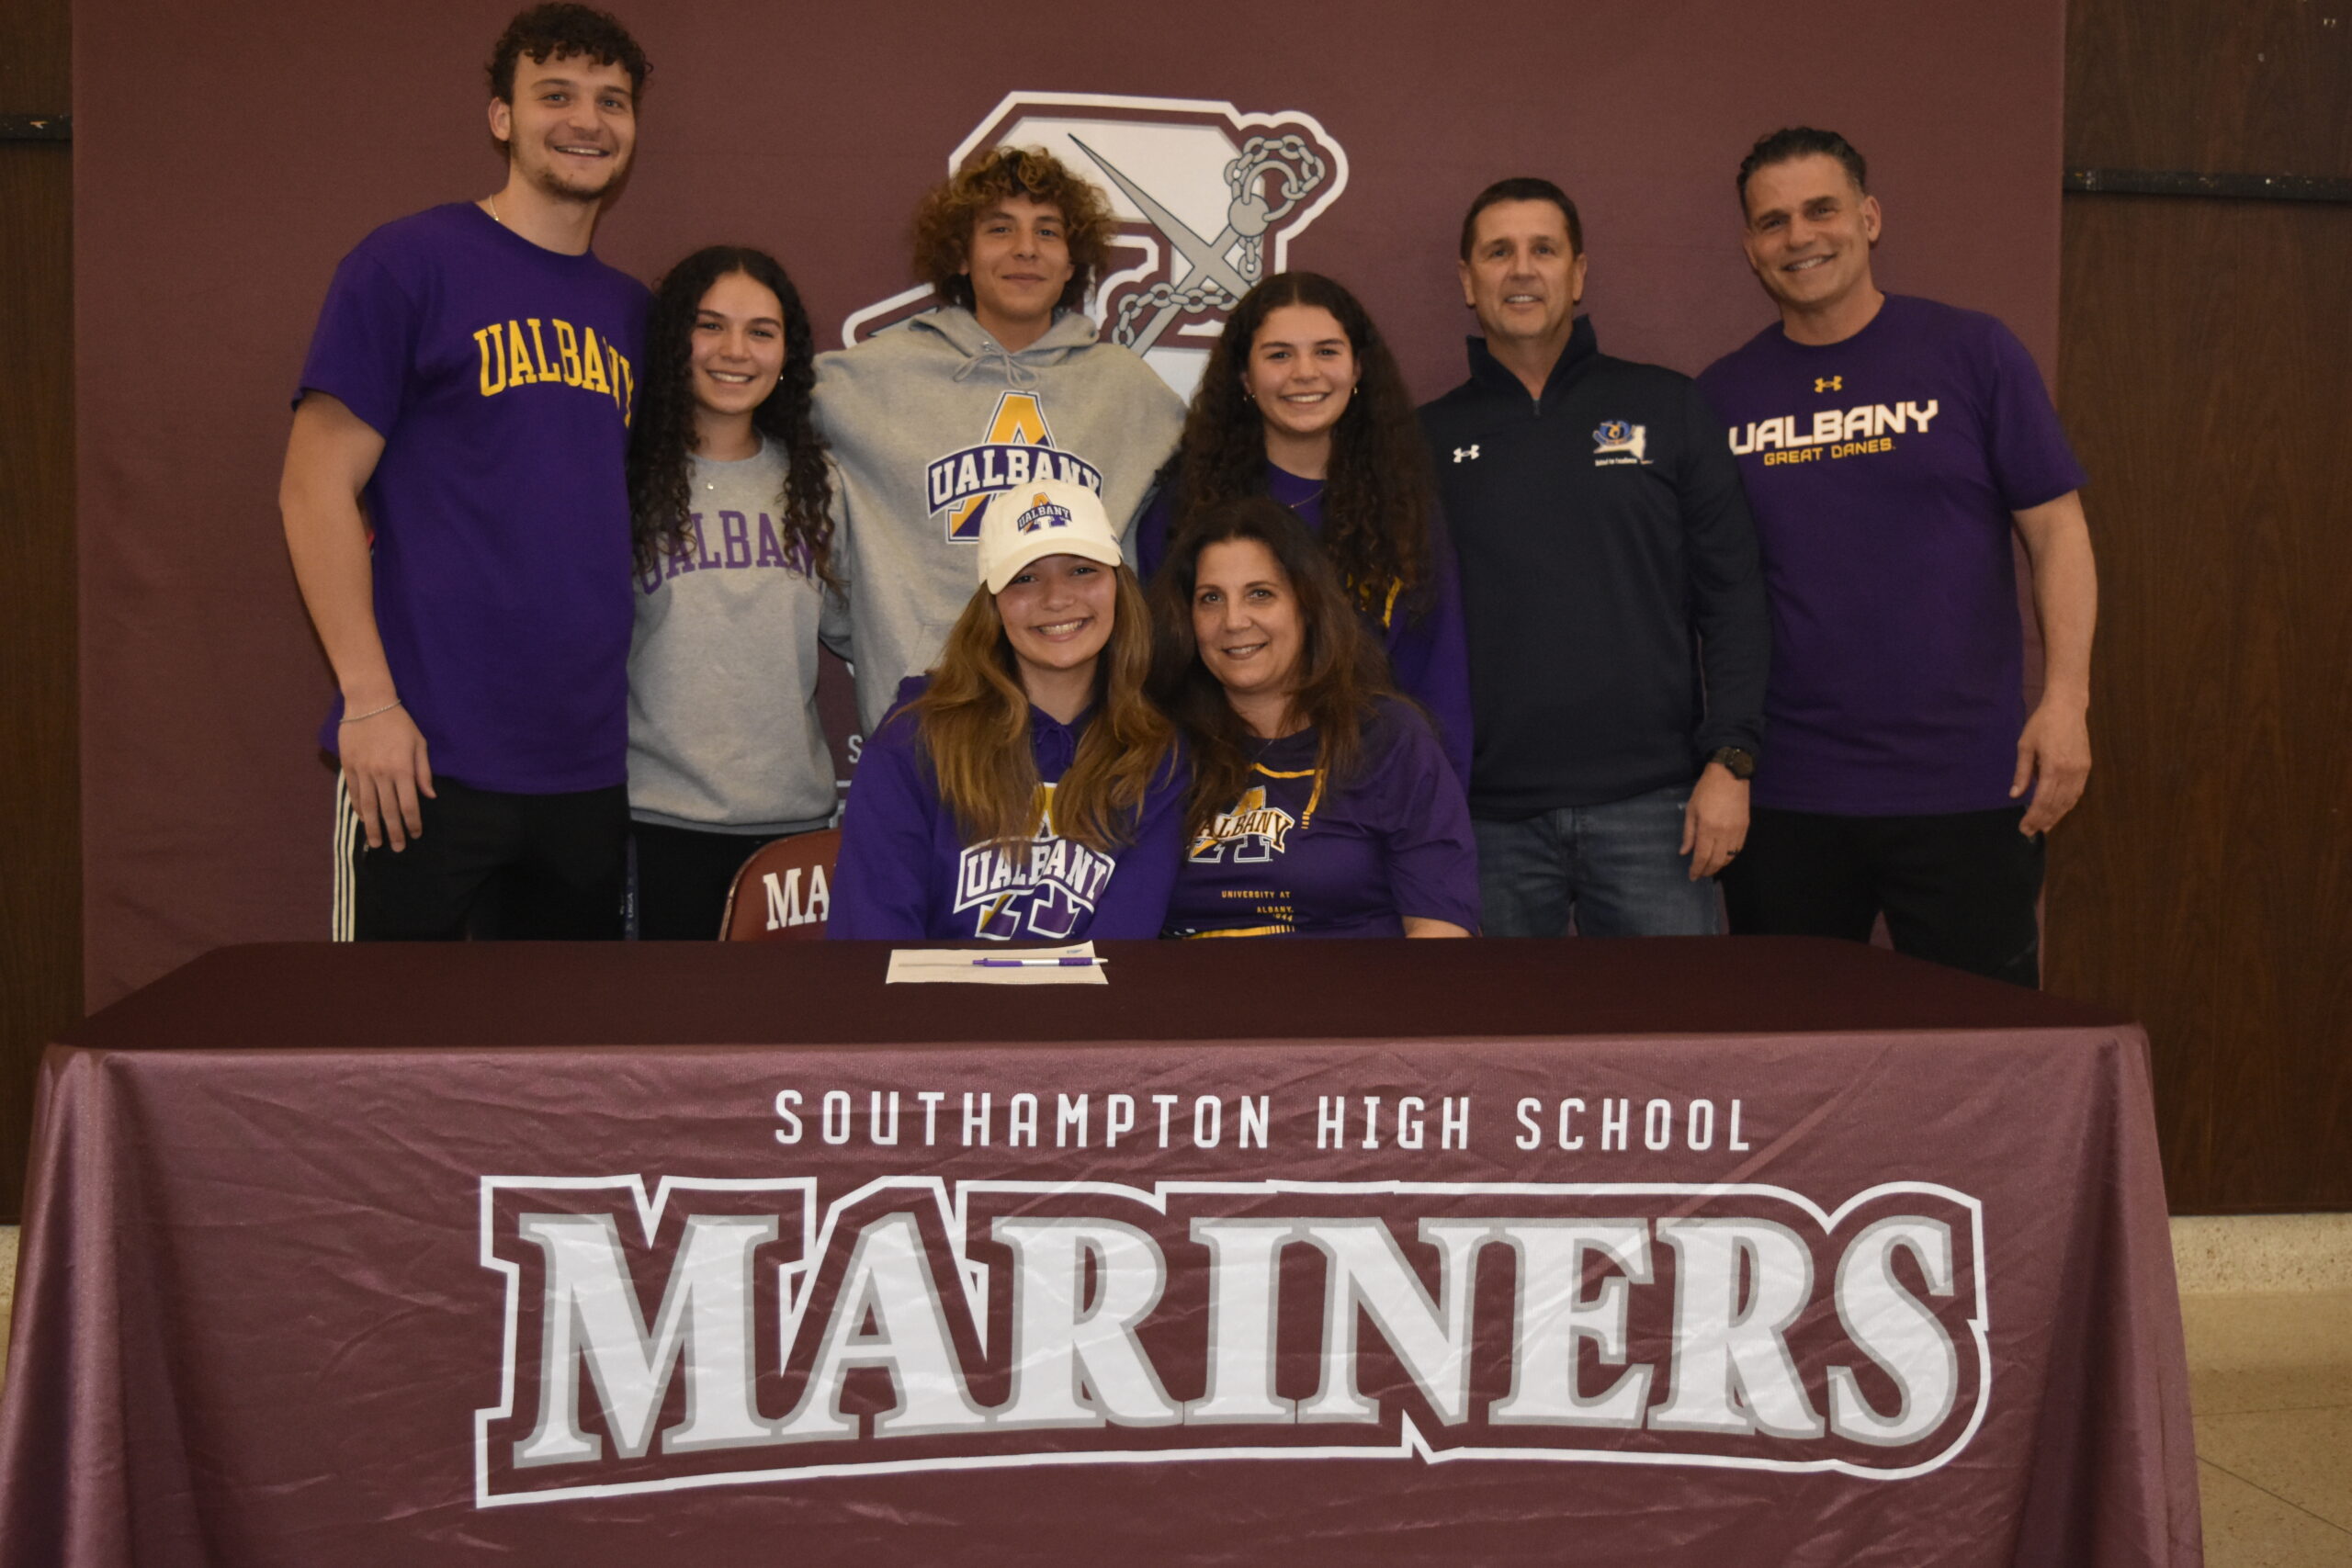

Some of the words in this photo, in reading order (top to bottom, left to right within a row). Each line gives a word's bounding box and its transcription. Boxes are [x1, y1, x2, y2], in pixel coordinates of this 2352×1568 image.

[1728, 400, 1939, 455] UALBANY
[1763, 446, 1824, 466] GREAT
[1017, 504, 1069, 529] UALBANY
[1193, 811, 1294, 851] ALBANY
[1221, 890, 1275, 899] UNIVERSITY
[1280, 890, 1291, 899] AT
[775, 1089, 1270, 1150] SOUTHAMPTON
[1317, 1095, 1470, 1151] HIGH
[1516, 1097, 1750, 1153] SCHOOL
[513, 1211, 1960, 1469] MARINERS
